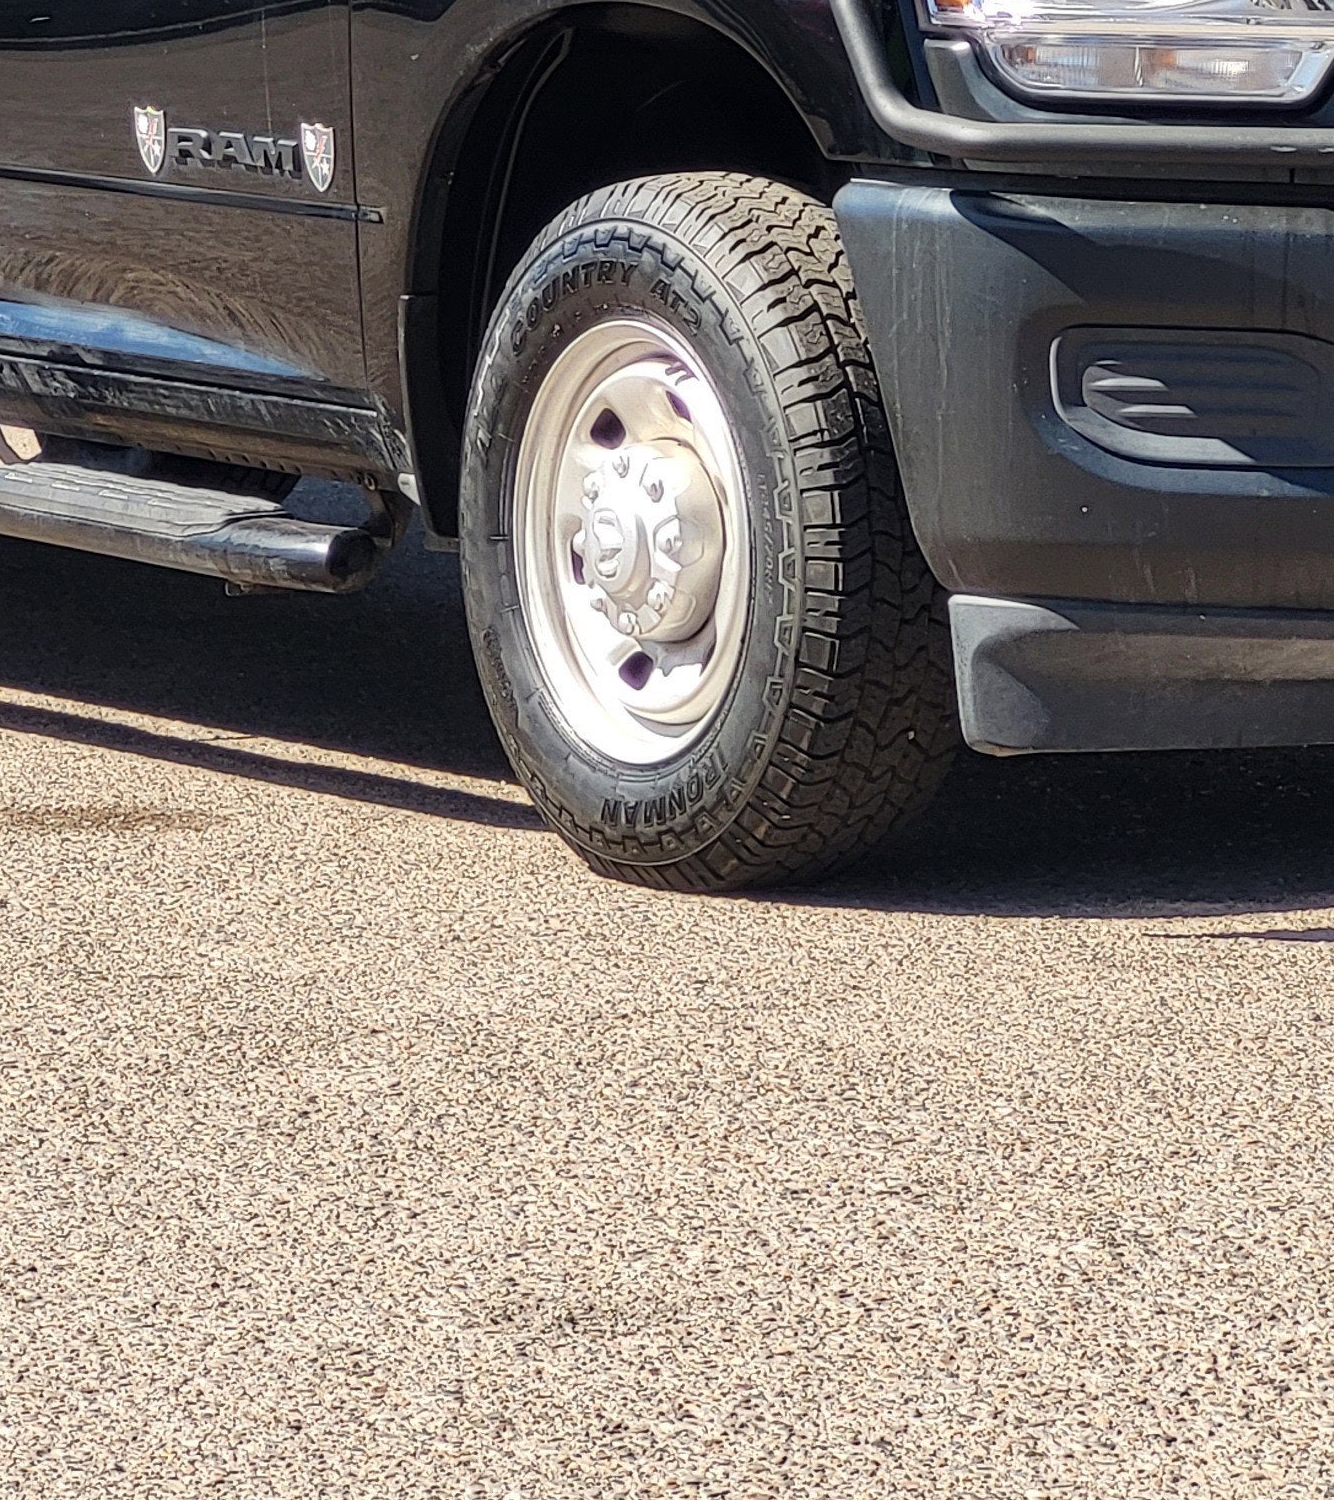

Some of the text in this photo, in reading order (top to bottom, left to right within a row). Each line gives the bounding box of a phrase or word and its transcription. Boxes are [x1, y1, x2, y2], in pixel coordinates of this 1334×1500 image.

[167, 127, 301, 177] RAM
[511, 257, 639, 356] COUNTRY
[649, 277, 704, 336] AT2
[600, 742, 730, 829] IRONMAN
